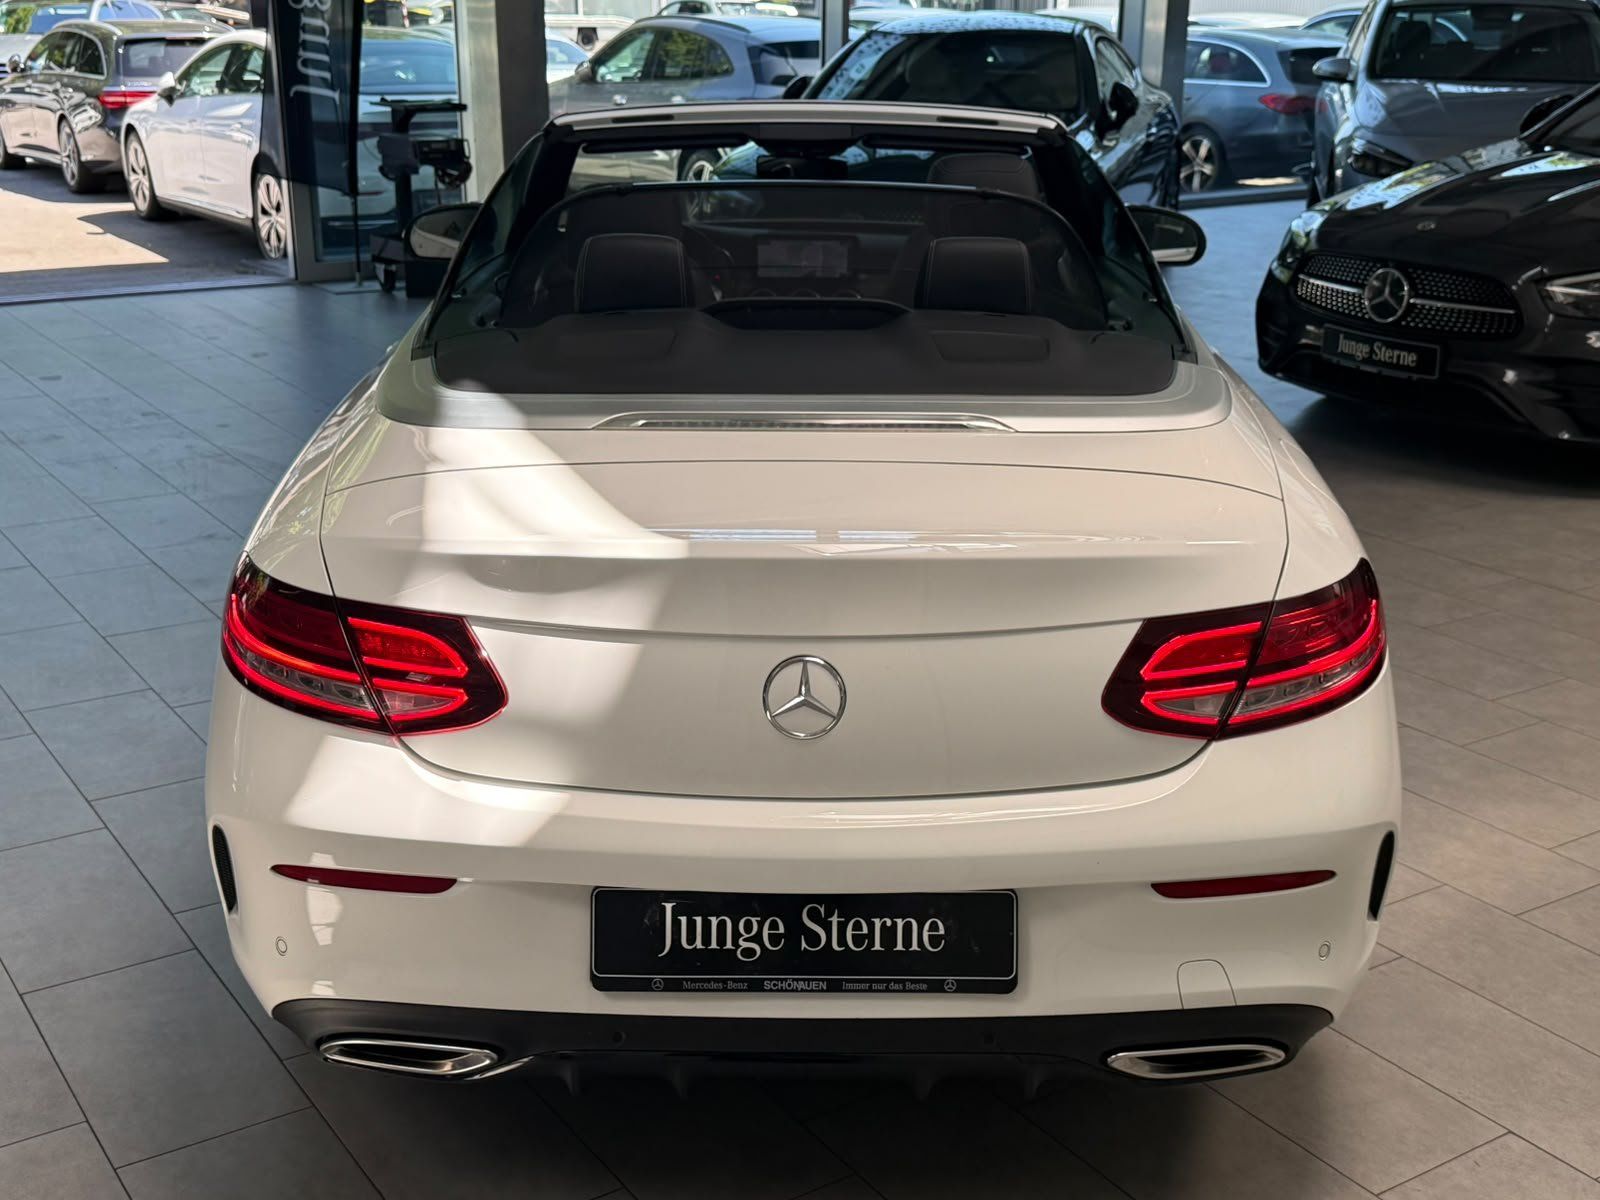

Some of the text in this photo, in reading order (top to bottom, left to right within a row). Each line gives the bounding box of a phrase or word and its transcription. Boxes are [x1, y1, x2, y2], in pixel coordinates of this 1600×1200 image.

[1338, 333, 1417, 367] Junge Sterne
[657, 902, 946, 962] Junge Sterne
[682, 979, 928, 990] Mercedes-Benz SCHÖNAUEN Immer nur das Beste
